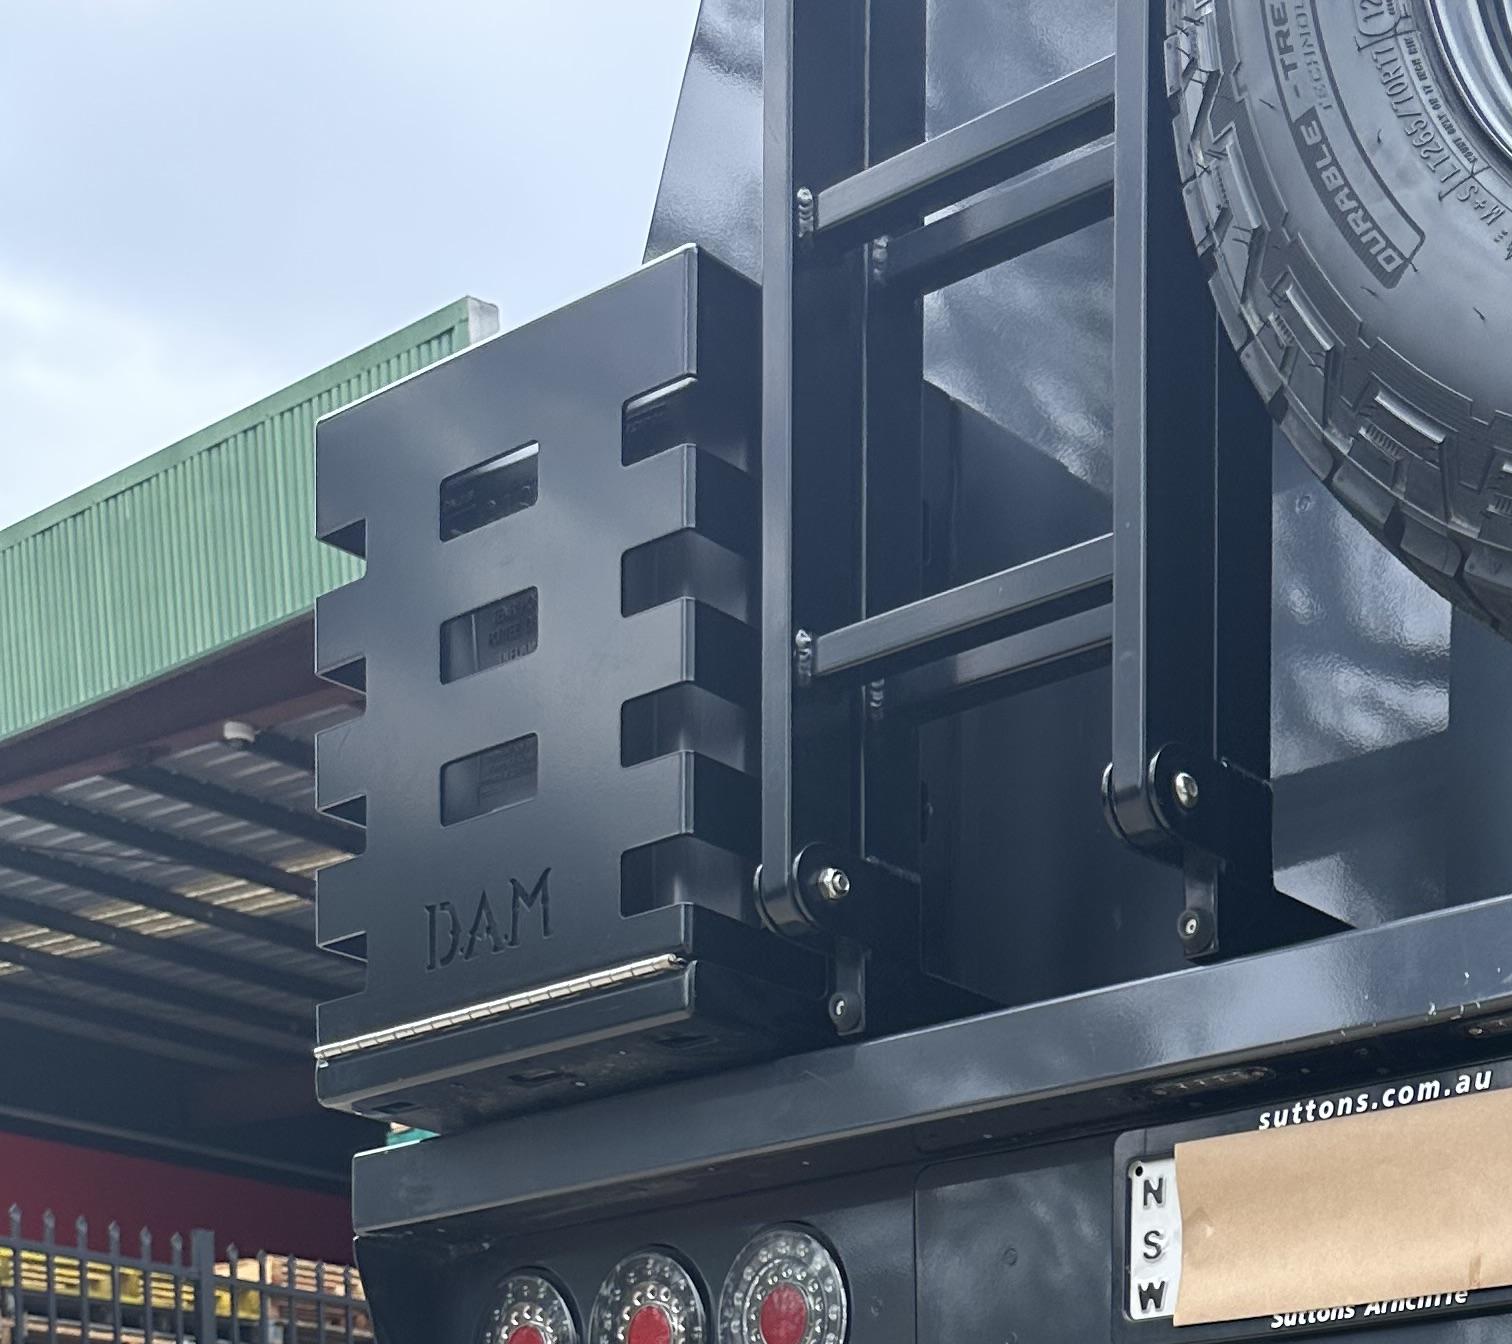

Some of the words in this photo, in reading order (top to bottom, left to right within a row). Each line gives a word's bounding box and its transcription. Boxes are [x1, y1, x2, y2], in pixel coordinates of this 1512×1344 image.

[1300, 119, 1403, 273] DURABLE
[424, 867, 552, 972] DAM
[1258, 1069, 1493, 1131] suttons.com.au
